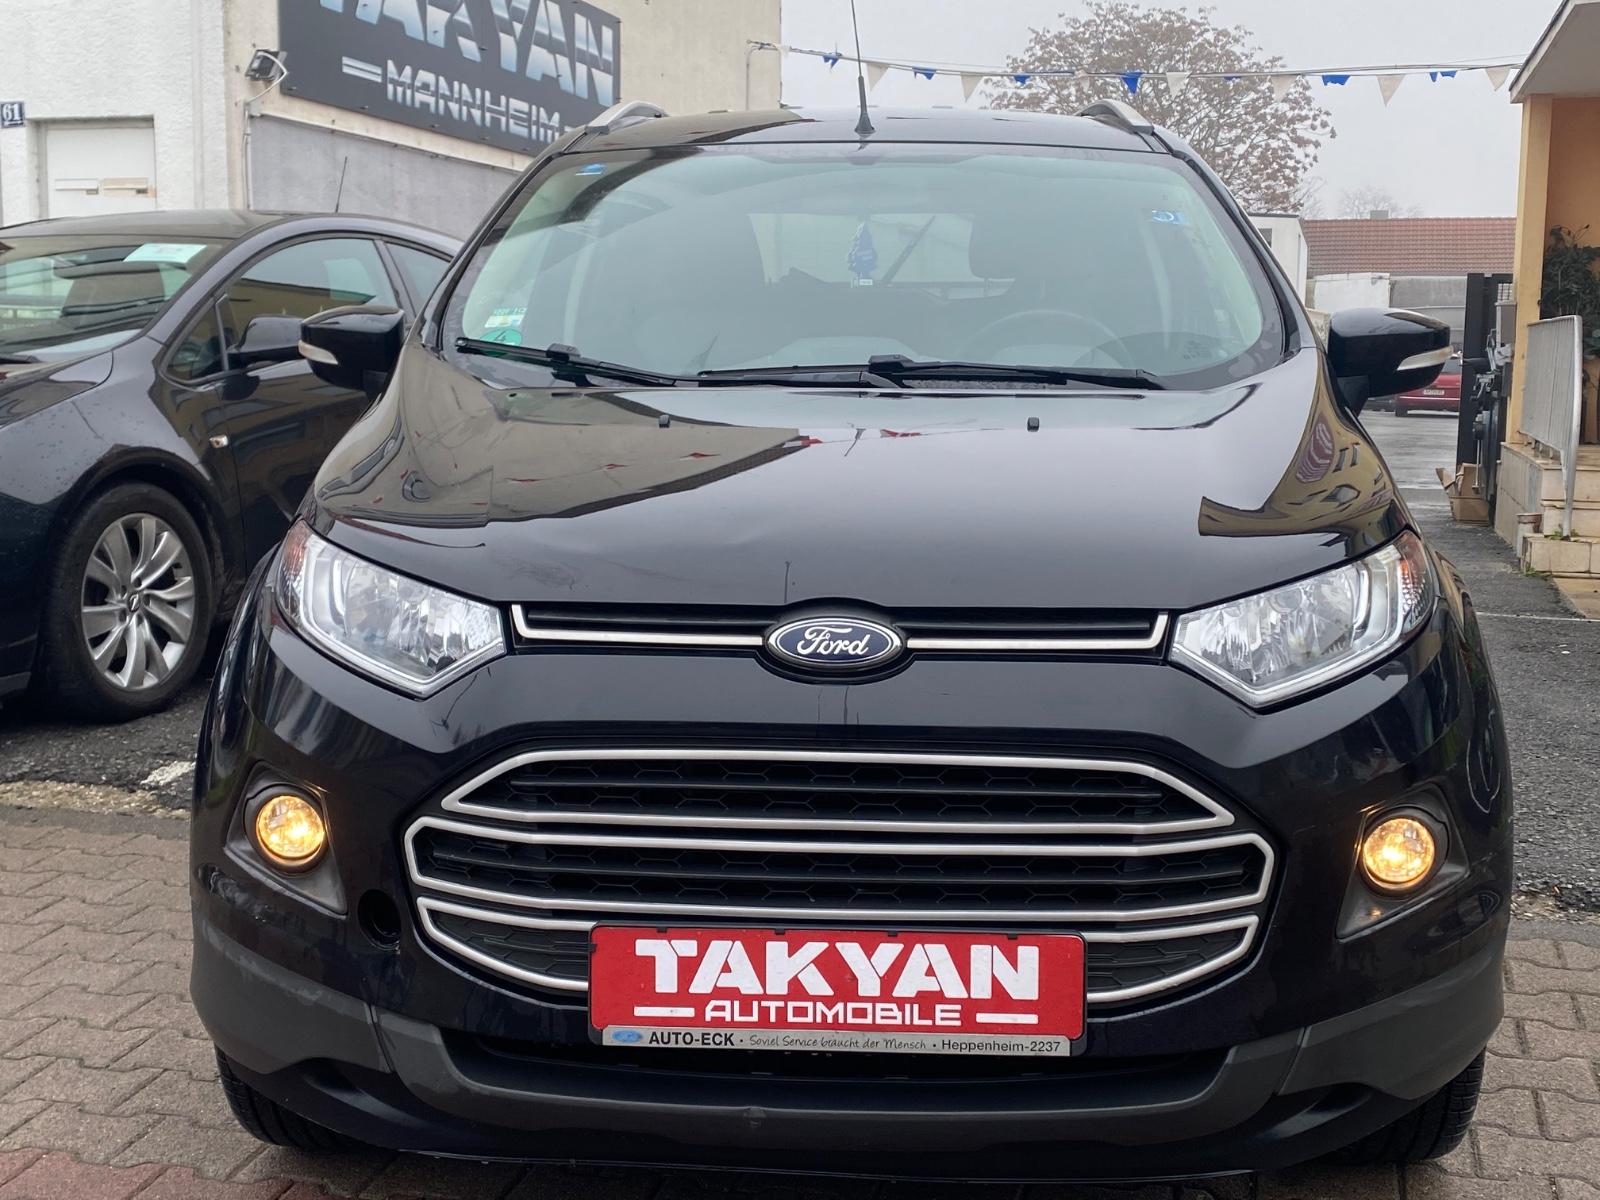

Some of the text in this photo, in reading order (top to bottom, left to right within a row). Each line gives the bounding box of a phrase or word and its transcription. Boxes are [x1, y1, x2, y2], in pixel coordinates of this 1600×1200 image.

[320, 0, 613, 107] KYAN
[3, 103, 20, 121] 61
[387, 59, 560, 145] MANNHEIM
[797, 626, 871, 655] Ford
[634, 938, 1041, 1001] TAKYAN
[704, 1000, 962, 1027] AUTOMOBILE
[649, 1031, 735, 1047] AUTO-ECK
[749, 1034, 779, 1047] Soviel
[820, 1036, 860, 1049] braucht
[862, 1038, 880, 1049] der
[883, 1038, 926, 1050] Mensch
[941, 1039, 1061, 1053] Heppenheim-2237
